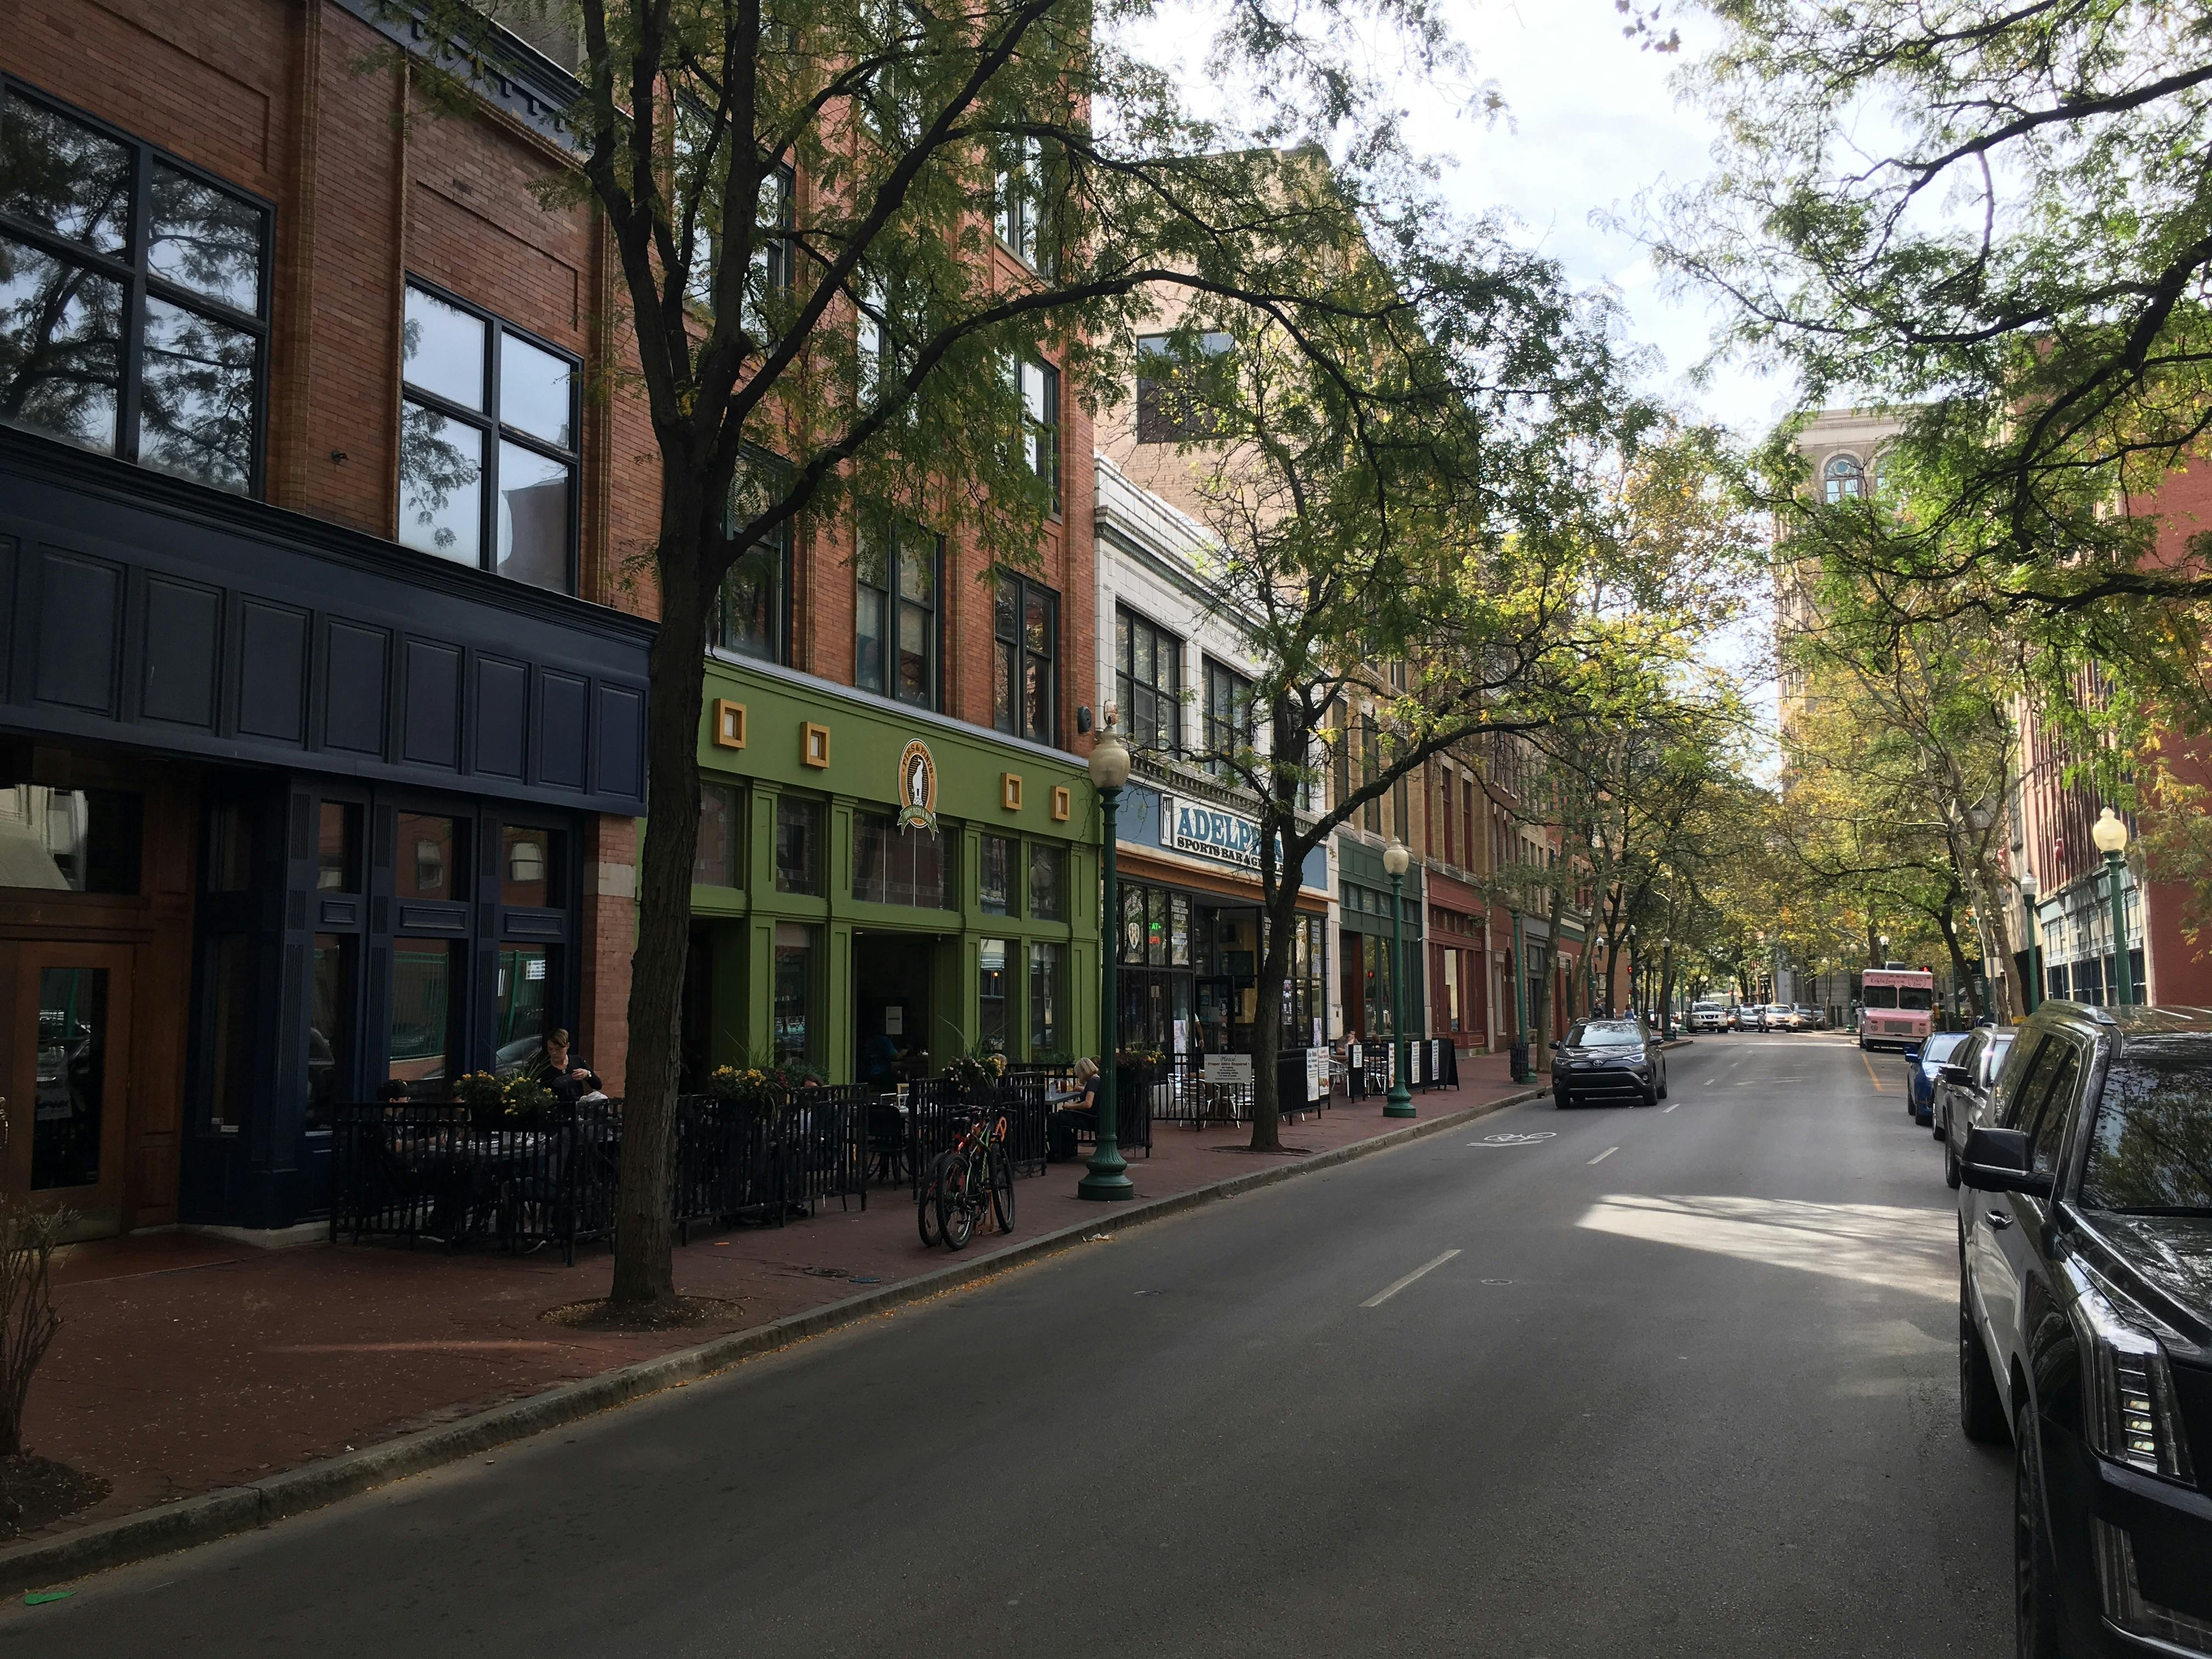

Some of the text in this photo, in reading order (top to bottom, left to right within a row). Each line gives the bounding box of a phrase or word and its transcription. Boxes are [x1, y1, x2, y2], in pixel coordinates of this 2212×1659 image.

[902, 744, 915, 766] PIES
[921, 747, 934, 774] PINTS
[913, 807, 922, 816] PIZZA
[1177, 836, 1220, 856] SPORTS
[1221, 848, 1243, 862] BAR
